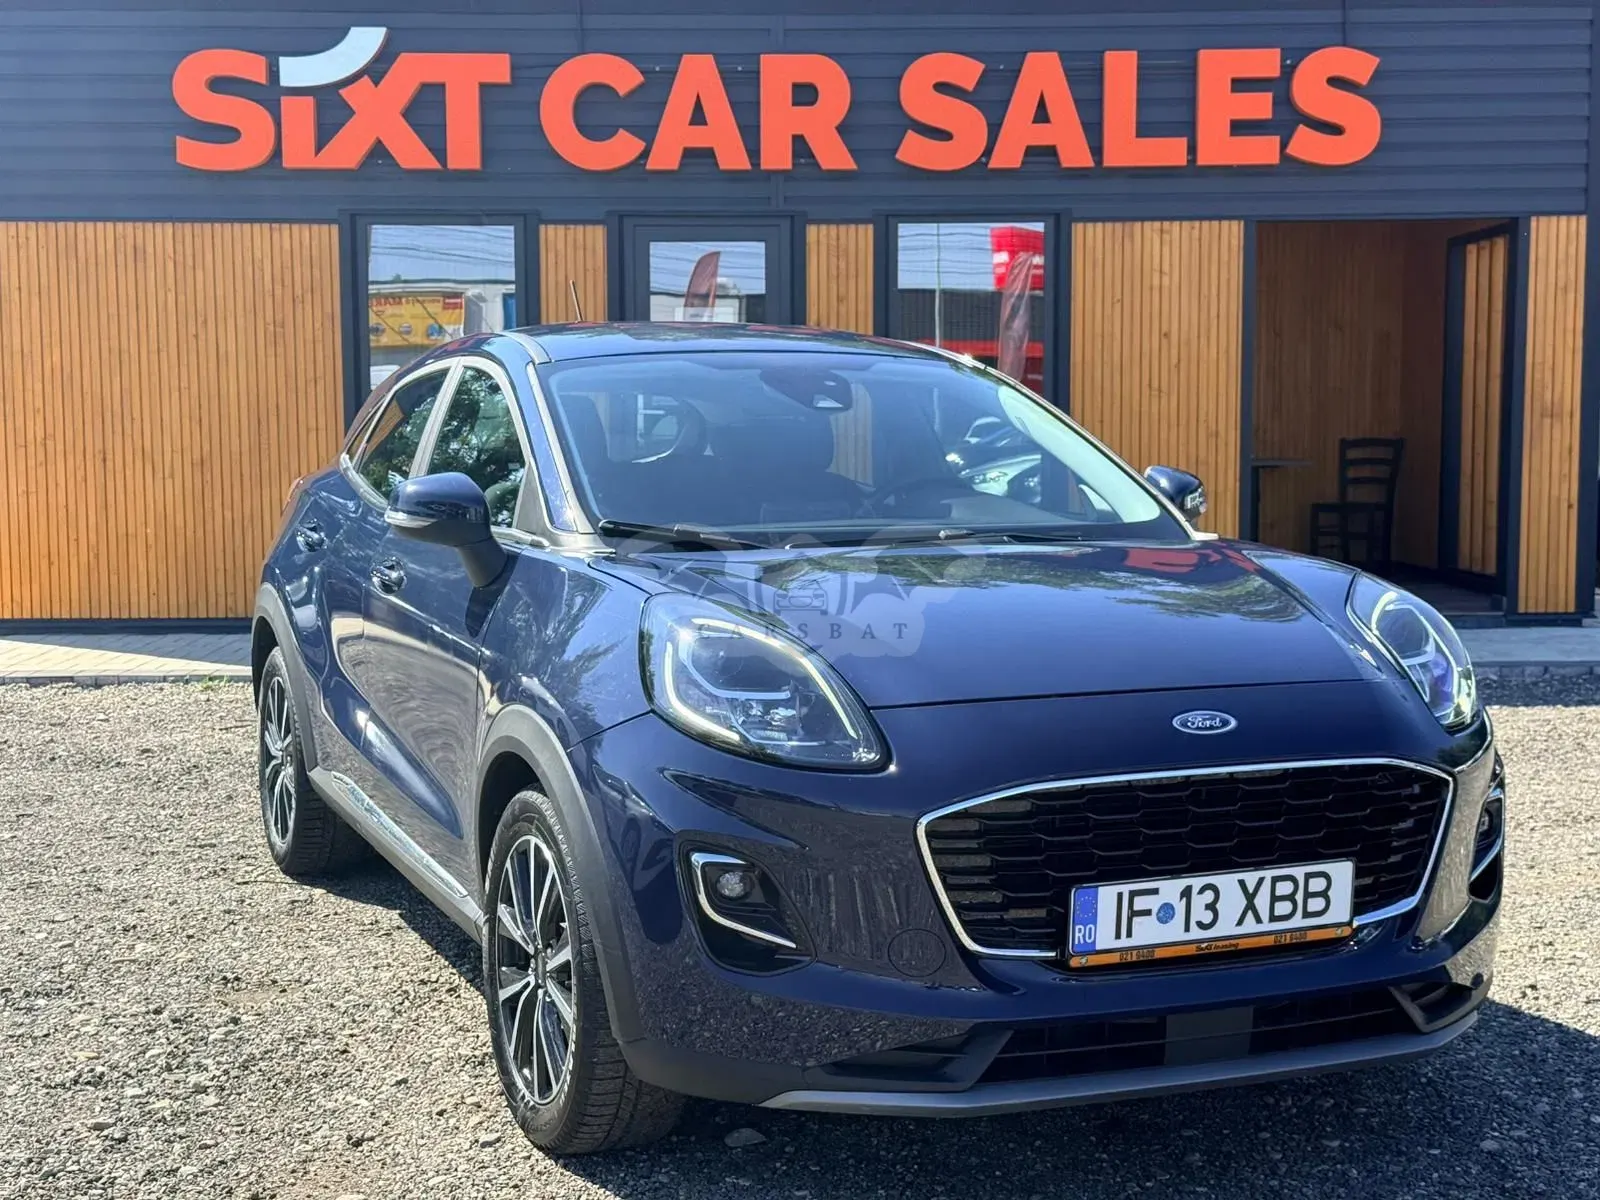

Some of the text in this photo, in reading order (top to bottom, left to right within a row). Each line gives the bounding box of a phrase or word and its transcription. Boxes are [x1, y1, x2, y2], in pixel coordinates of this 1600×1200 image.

[539, 52, 858, 171] CAR
[895, 46, 1383, 171] SALES
[1186, 714, 1223, 729] Ford
[1114, 870, 1333, 941] IF 13 XBB
[1074, 924, 1096, 944] RO
